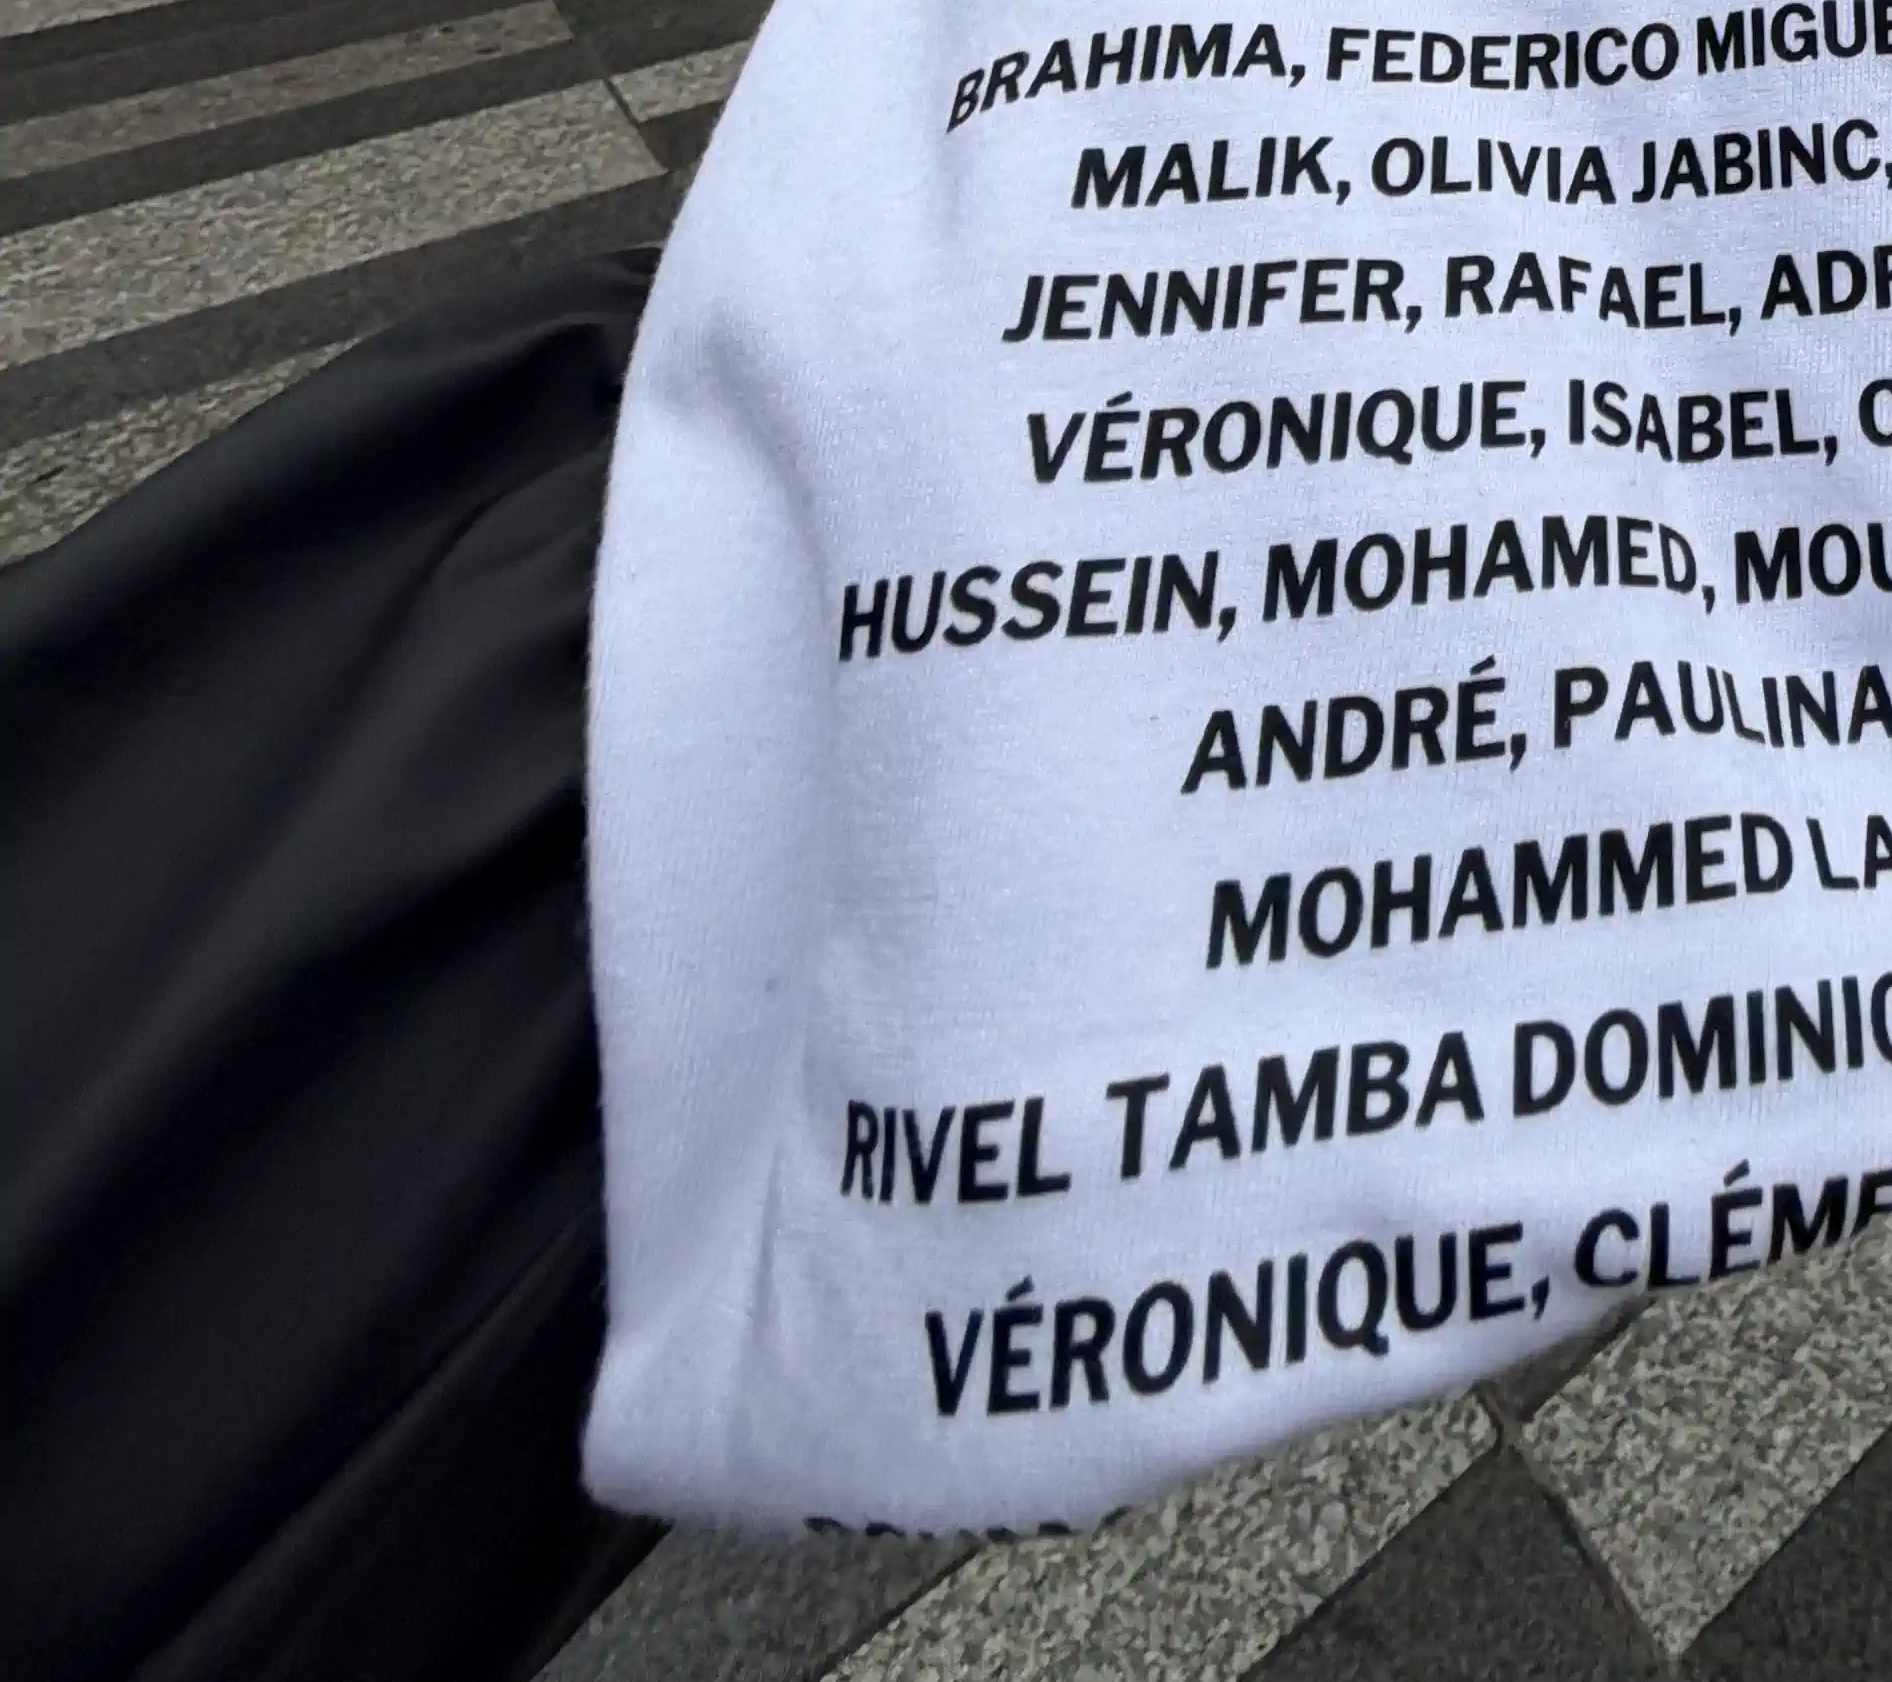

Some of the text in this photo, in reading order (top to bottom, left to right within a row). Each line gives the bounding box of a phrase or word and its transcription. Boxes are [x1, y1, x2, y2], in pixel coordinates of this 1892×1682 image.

[945, 22, 1307, 135] BRAHIMA,
[1325, 21, 1681, 91] FEDERICO
[1070, 135, 1352, 210] MALIK,
[1370, 135, 1618, 206] OLIVIA
[1001, 257, 1423, 344] JENNIFER,
[1444, 250, 1743, 338] RAFAEL,
[1026, 379, 1547, 485] VÉRONIQUE,
[1568, 377, 1839, 468] ISABEL,
[837, 549, 1238, 664] HUSSEIN,
[1261, 514, 1717, 623] MOHAMED,
[1179, 653, 1528, 795] ANDRÉ,
[1205, 812, 1794, 970] MOHAMMED
[839, 1096, 1073, 1207] RIVEL
[1105, 1030, 1486, 1182] TAMBA
[923, 1219, 1552, 1419] VÉRONIQUE,
